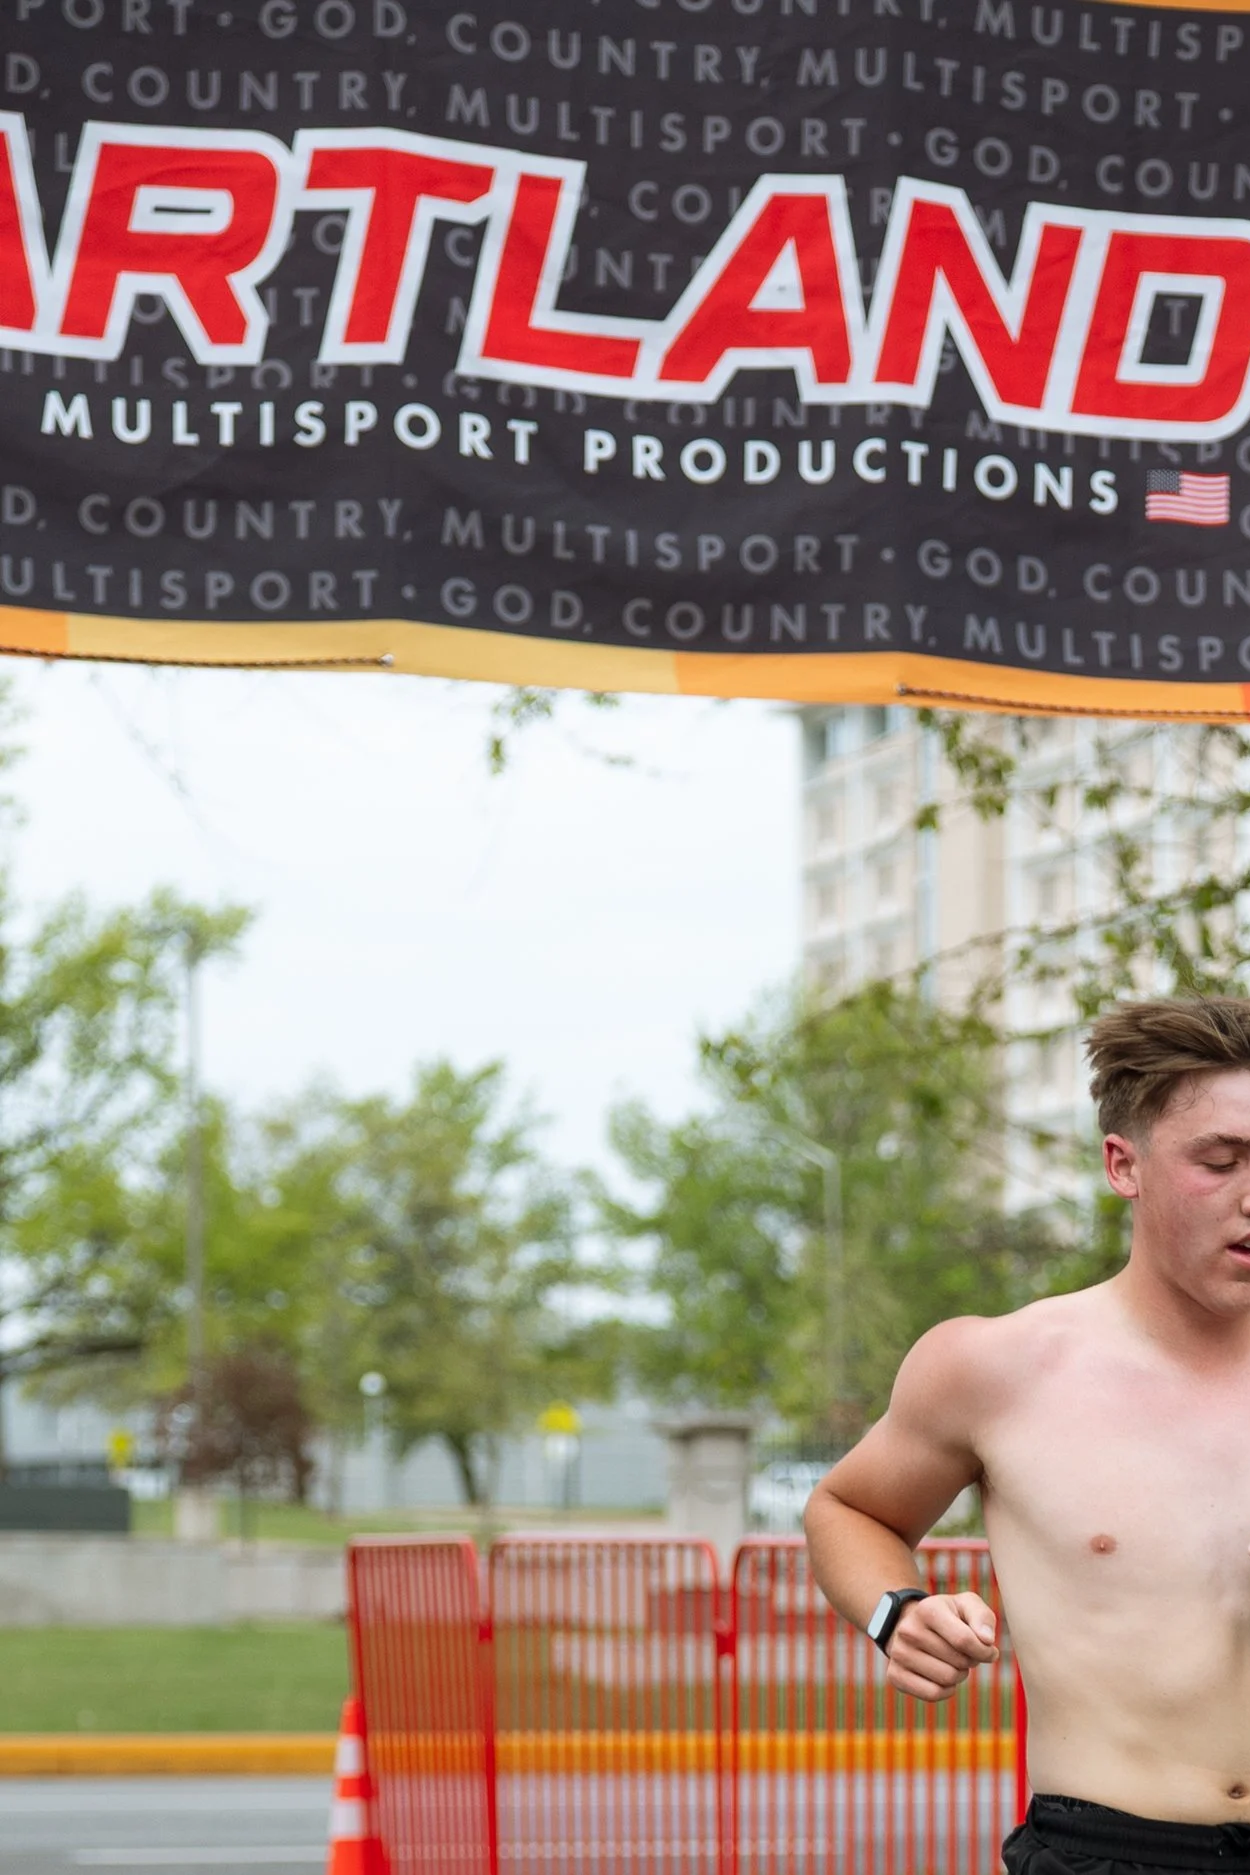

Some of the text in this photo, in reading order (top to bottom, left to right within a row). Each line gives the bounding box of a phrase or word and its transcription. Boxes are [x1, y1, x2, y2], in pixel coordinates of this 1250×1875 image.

[81, 61, 417, 117] COUNTRY,
[445, 83, 868, 156] MULTISPORT
[924, 127, 1068, 192] GOD,
[258, 0, 417, 46] GOD,
[445, 13, 770, 88] COUNTRY,
[796, 46, 1200, 130] MULTISPORT
[41, 390, 1119, 514] MULTISPORT PRODUCTIONS
[78, 494, 413, 541] COUNTRY,
[441, 506, 859, 573] MULTISPORT
[917, 538, 1057, 598] GOD,
[440, 577, 593, 634] GOD,
[622, 598, 937, 647] COUNTRY,
